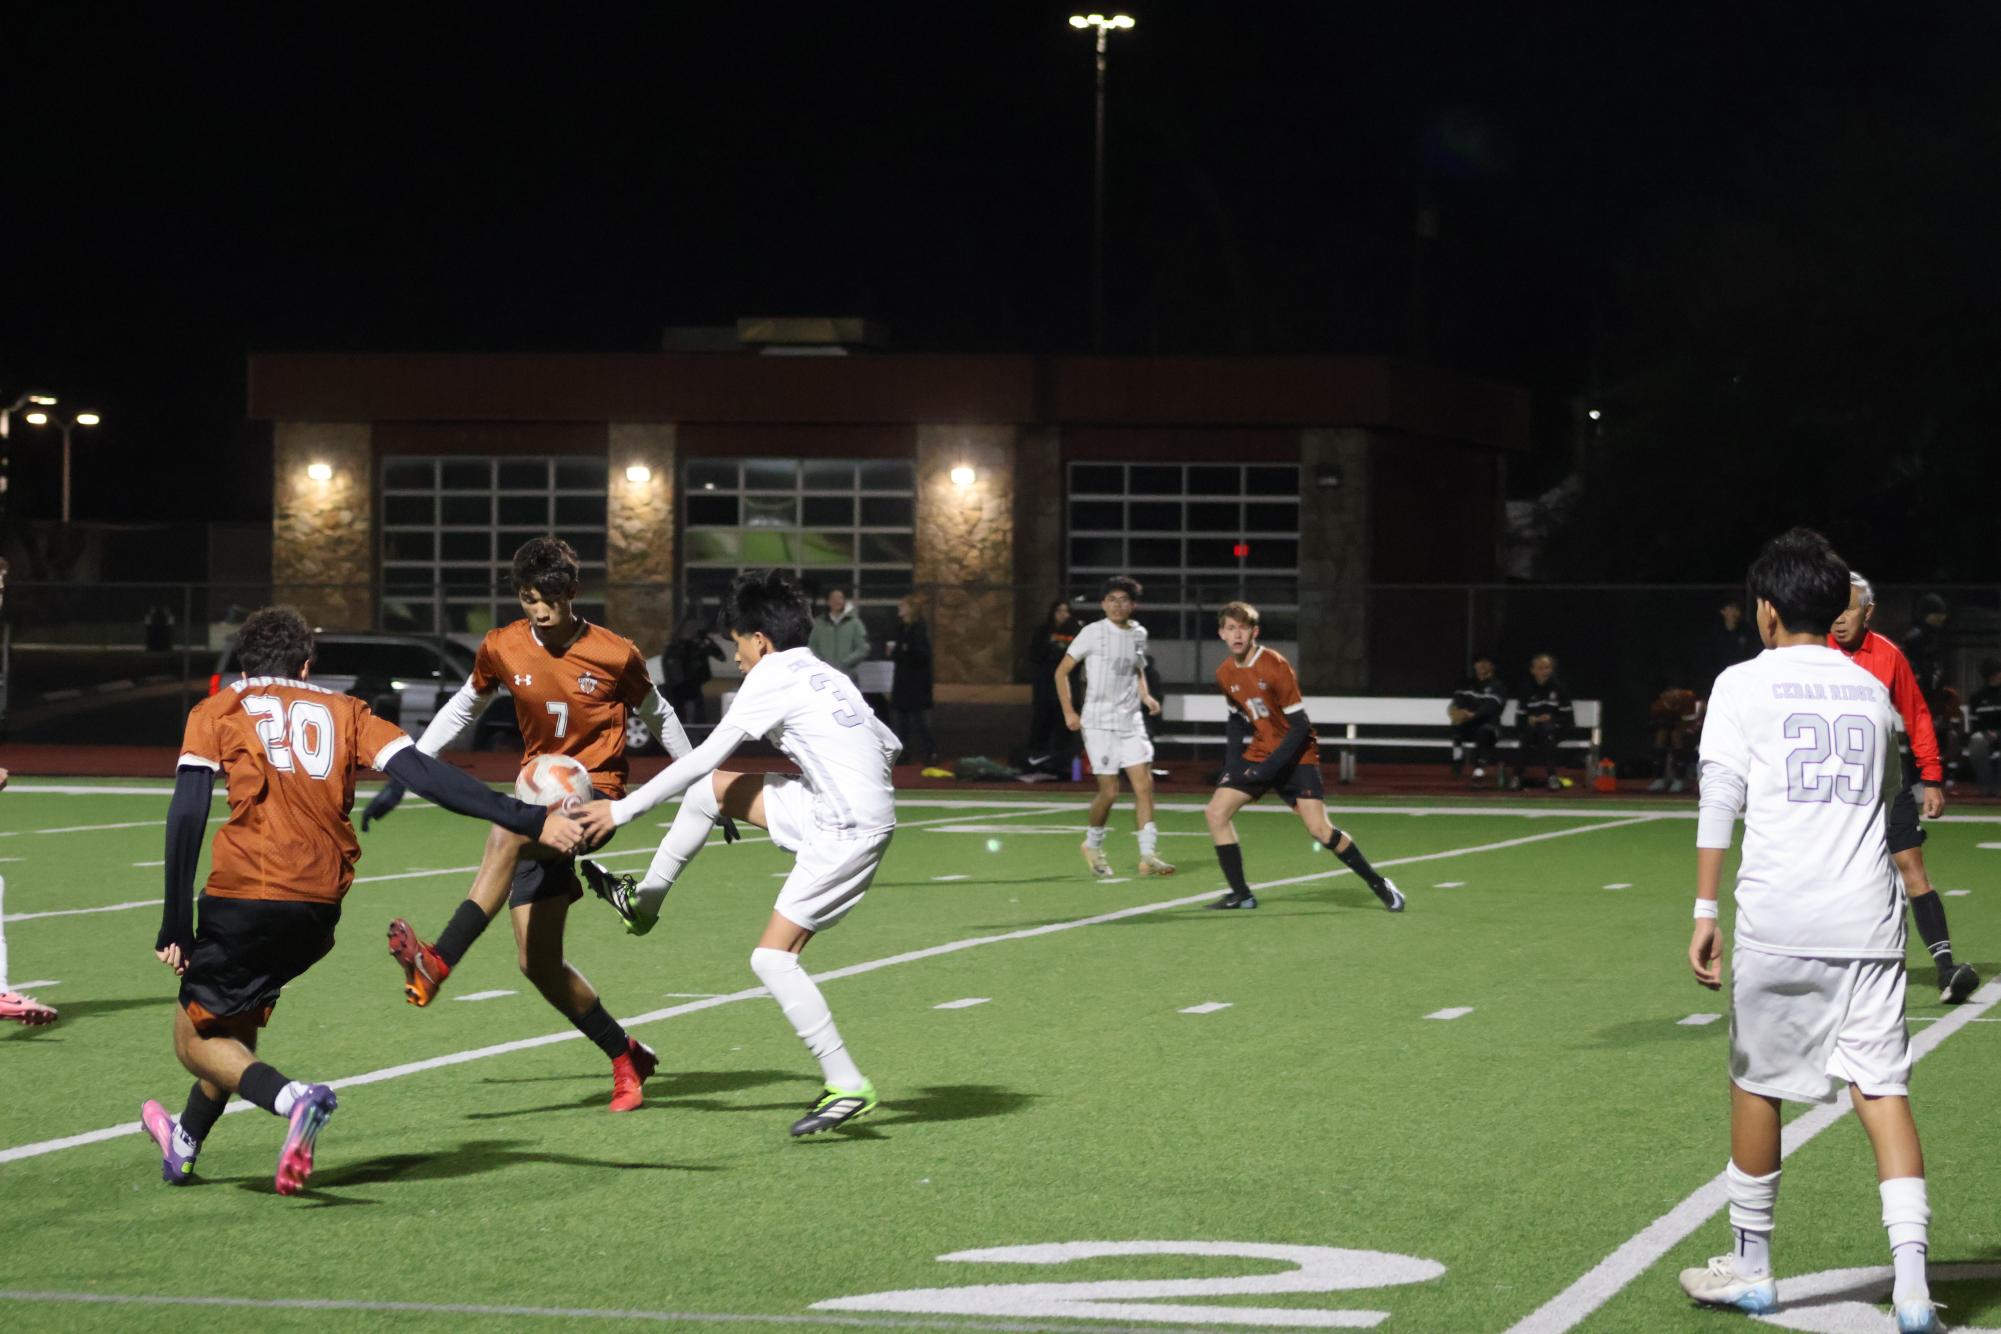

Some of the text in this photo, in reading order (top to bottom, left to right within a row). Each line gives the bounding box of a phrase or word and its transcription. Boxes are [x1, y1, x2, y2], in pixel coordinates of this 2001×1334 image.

[546, 701, 568, 738] 7
[809, 672, 865, 728] 3
[1771, 682, 1877, 702] CEDAR RIDGE
[240, 693, 335, 780] 20
[1783, 712, 1876, 807] 29
